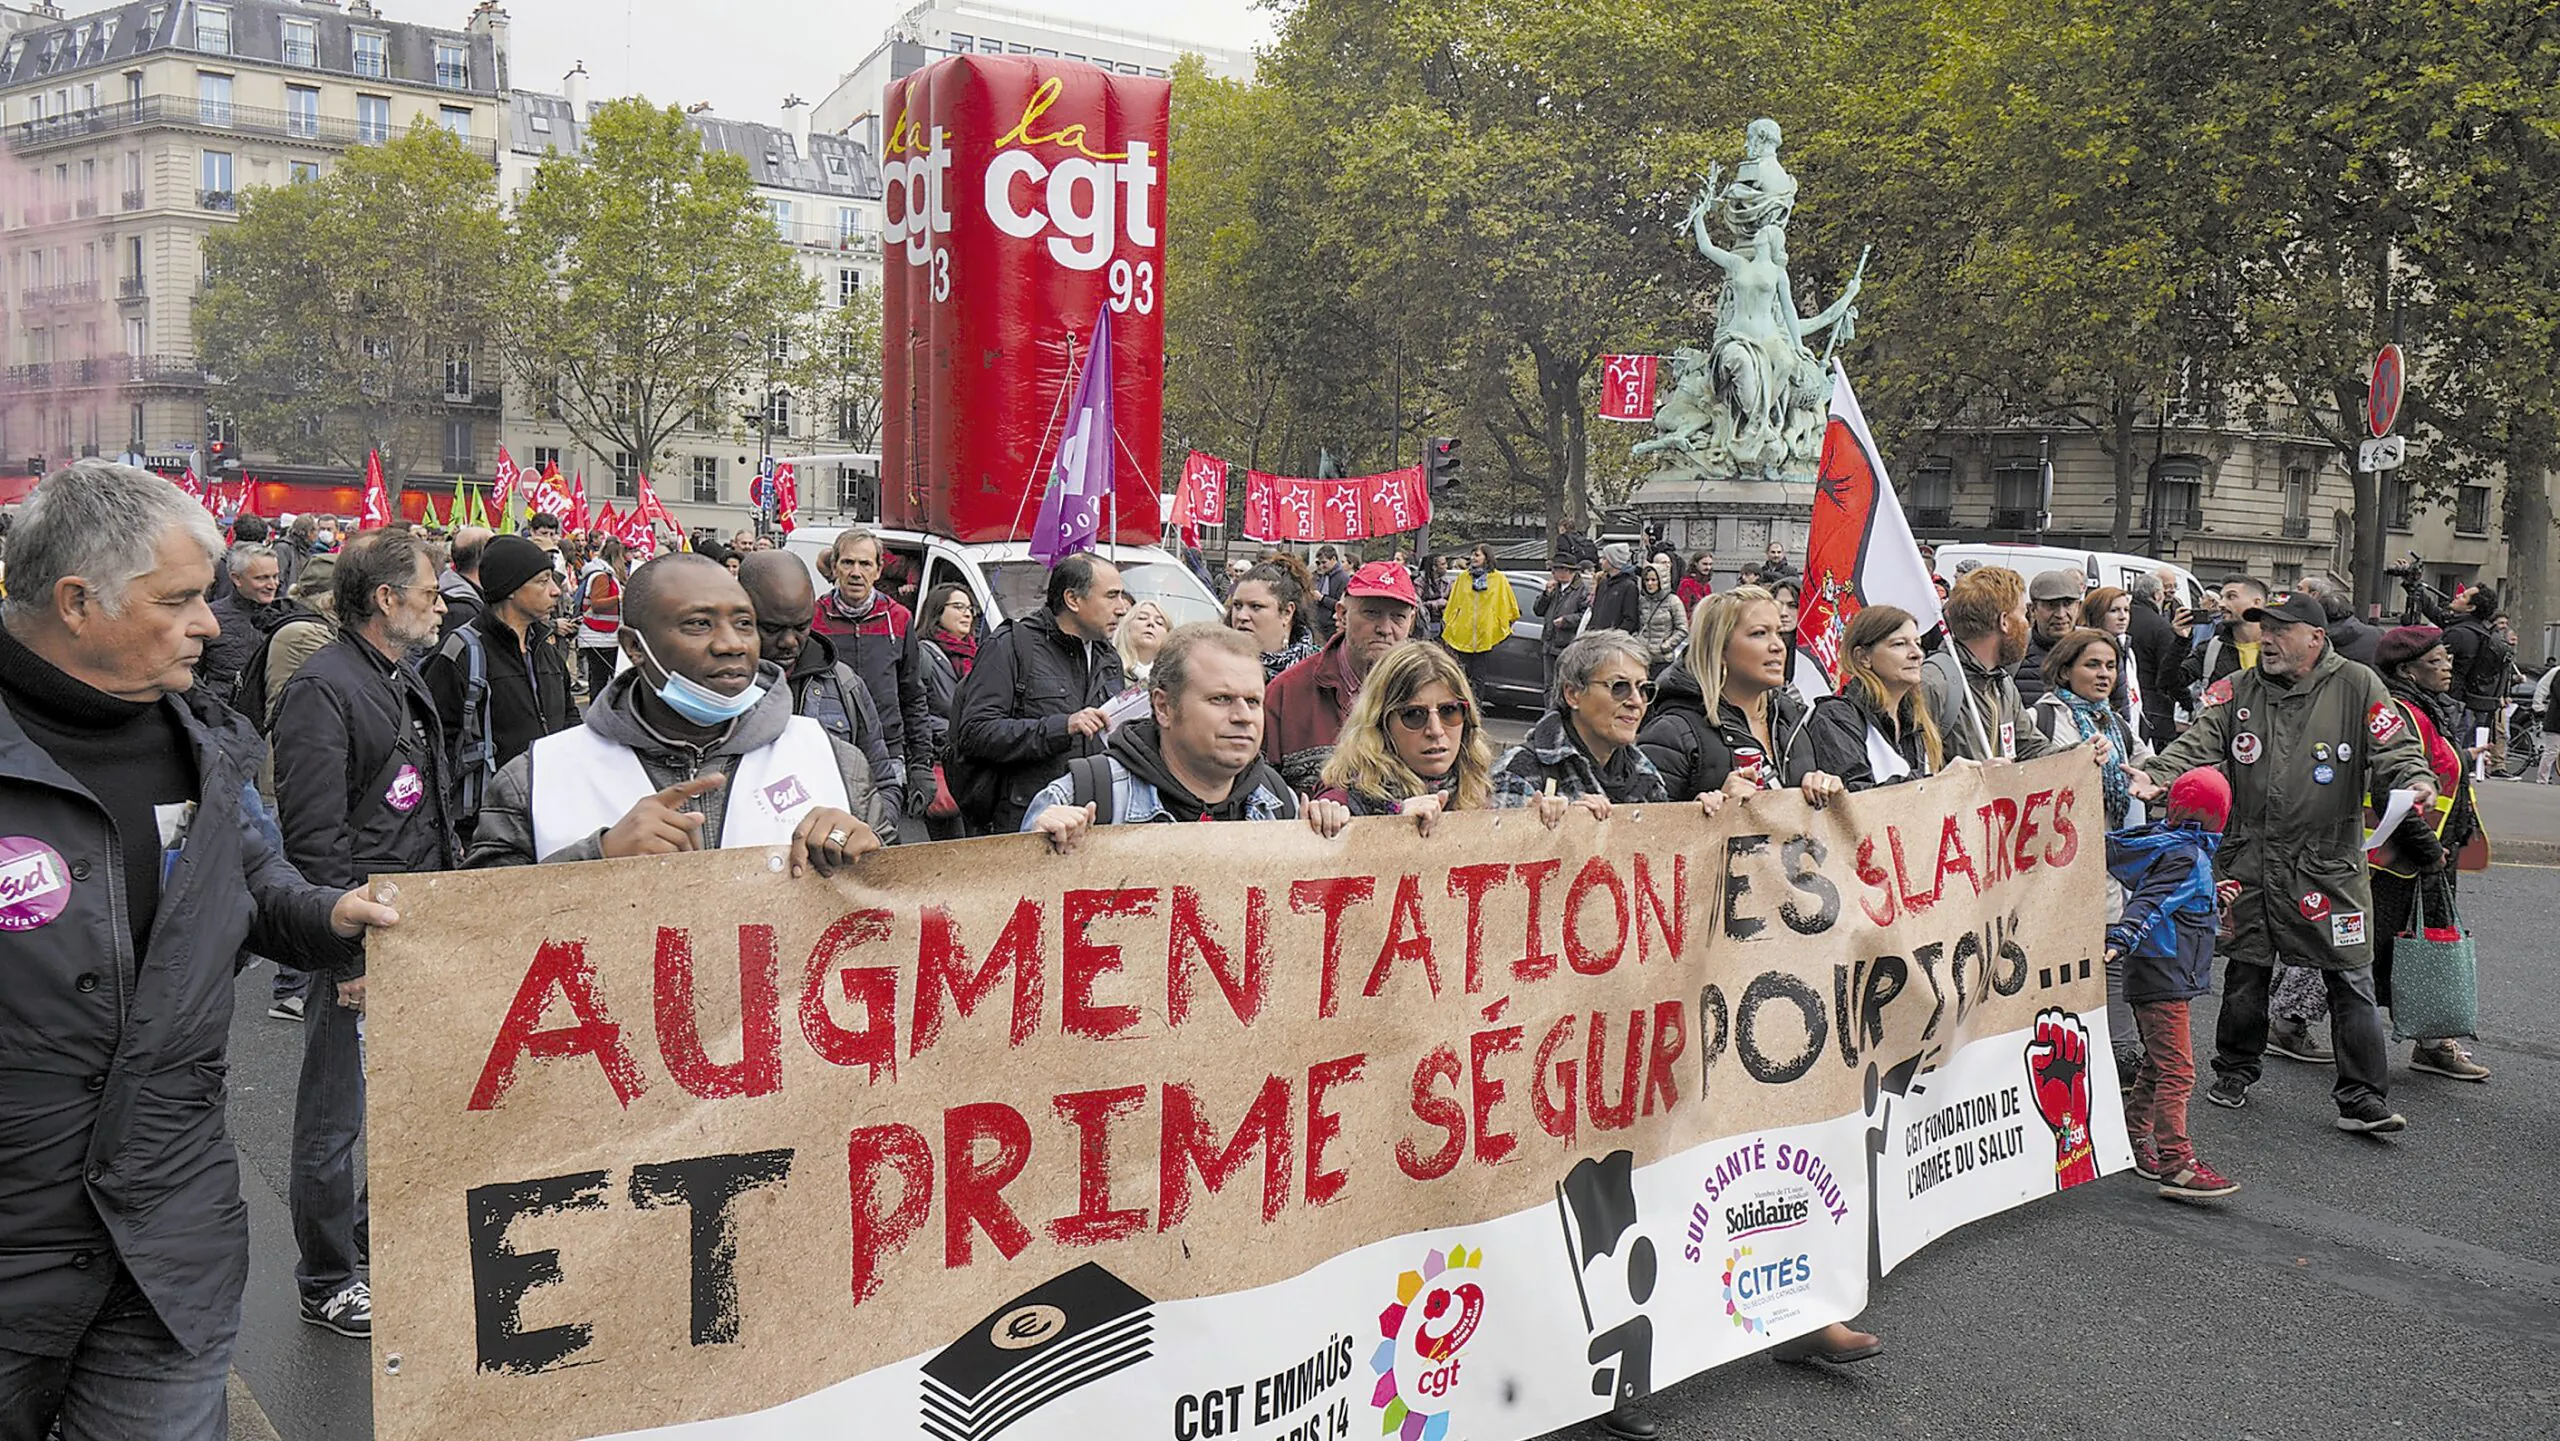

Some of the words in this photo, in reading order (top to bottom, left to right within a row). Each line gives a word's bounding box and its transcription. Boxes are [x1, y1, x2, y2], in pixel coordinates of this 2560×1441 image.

[995, 76, 1157, 159] la
[883, 126, 951, 266] cgt
[985, 141, 1156, 271] cgt
[1109, 259, 1154, 314] 93
[144, 456, 181, 467] LLIER
[2370, 708, 2397, 733] cgt
[466, 852, 1689, 1111] AUGMENTATION
[1905, 1120, 1924, 1157] CGT
[1925, 1093, 1997, 1146] FONDATION
[2001, 1086, 2020, 1118] DE
[466, 1147, 795, 1376] ET
[849, 1053, 1369, 1307] PRIME
[1395, 996, 1687, 1182] SÉGUR
[1685, 1202, 1709, 1263] SUD
[1705, 1138, 1766, 1202] SANTÉ
[1776, 1144, 1848, 1225] SOCIAUX
[1907, 1145, 1953, 1200] L'ARMÉE
[1956, 1141, 1974, 1174] DU
[1979, 1125, 2024, 1166] SALUT
[1726, 1197, 1809, 1234] Solidaires
[1174, 1385, 1244, 1441] CGT
[1254, 1332, 1353, 1427] EMMAÜS
[1418, 1358, 1461, 1397] cgt
